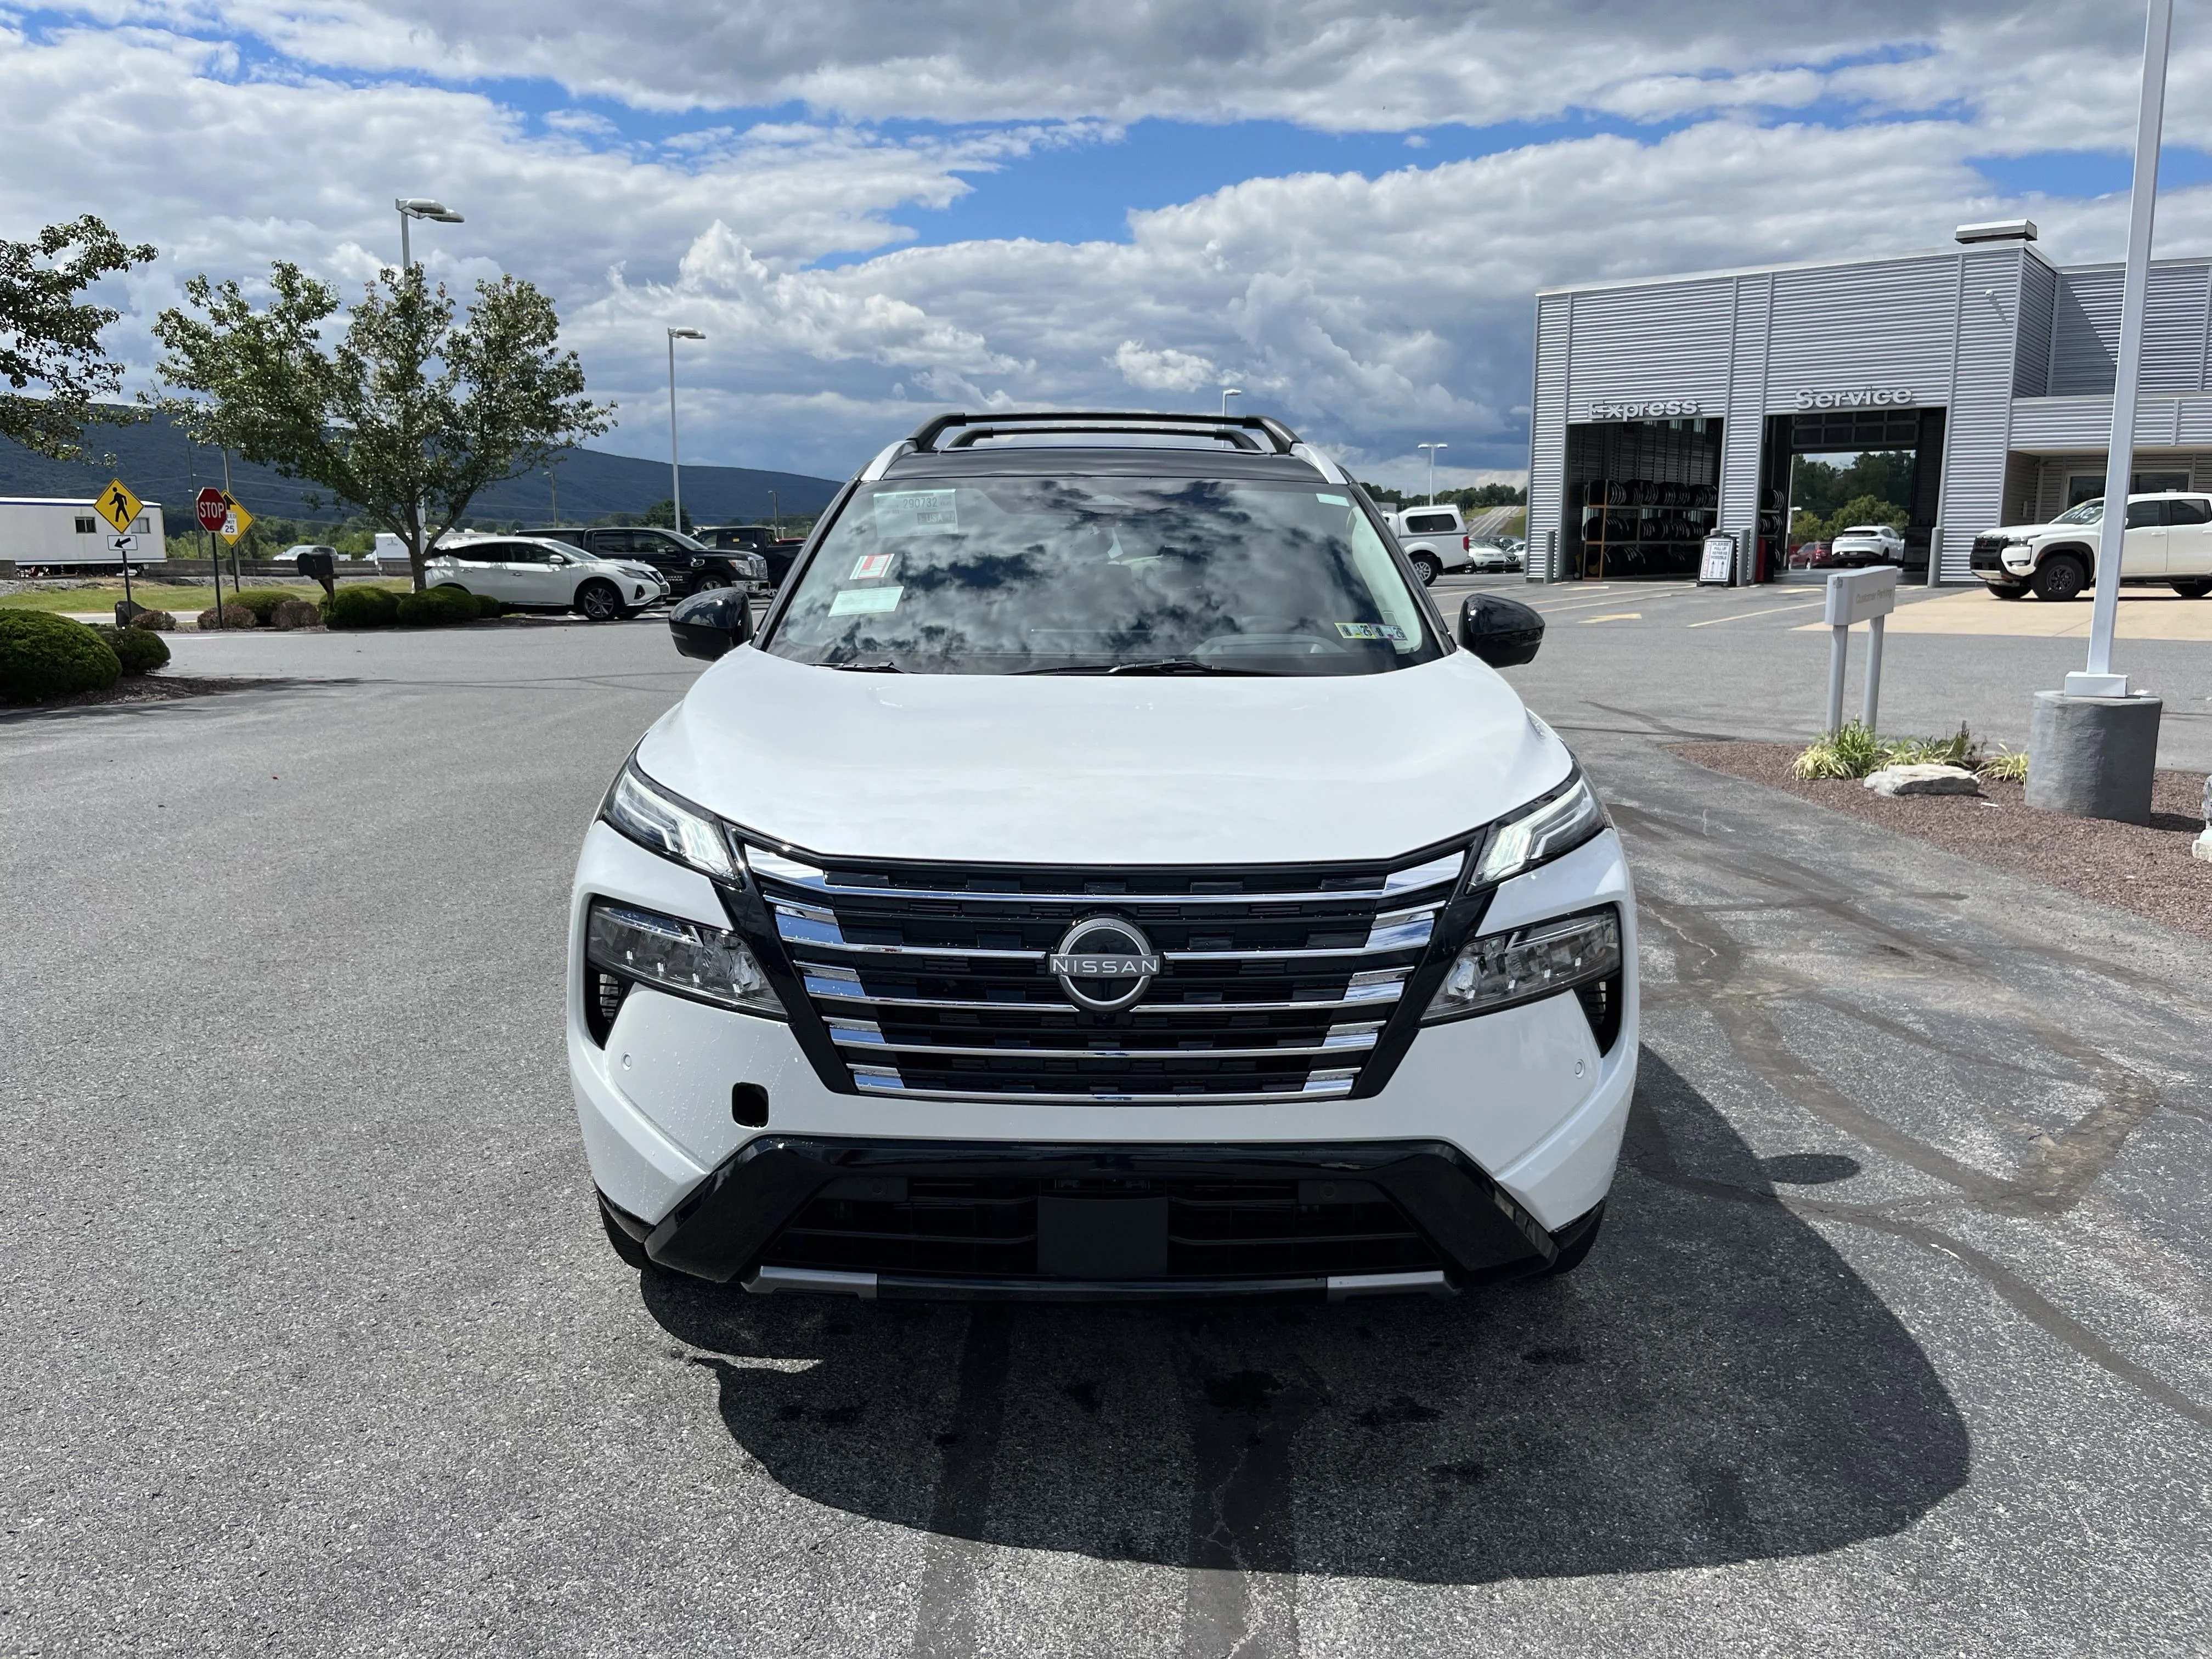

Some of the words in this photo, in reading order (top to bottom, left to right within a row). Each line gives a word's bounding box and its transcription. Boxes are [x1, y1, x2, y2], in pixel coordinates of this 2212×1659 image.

[1794, 386, 1912, 409] Service
[1588, 399, 1697, 422] Express
[200, 501, 224, 518] STOP
[903, 496, 938, 509] 290732
[225, 525, 235, 533] 25
[1360, 625, 1373, 636] 26
[1393, 627, 1405, 638] 26
[1053, 958, 1157, 973] NISSAN
